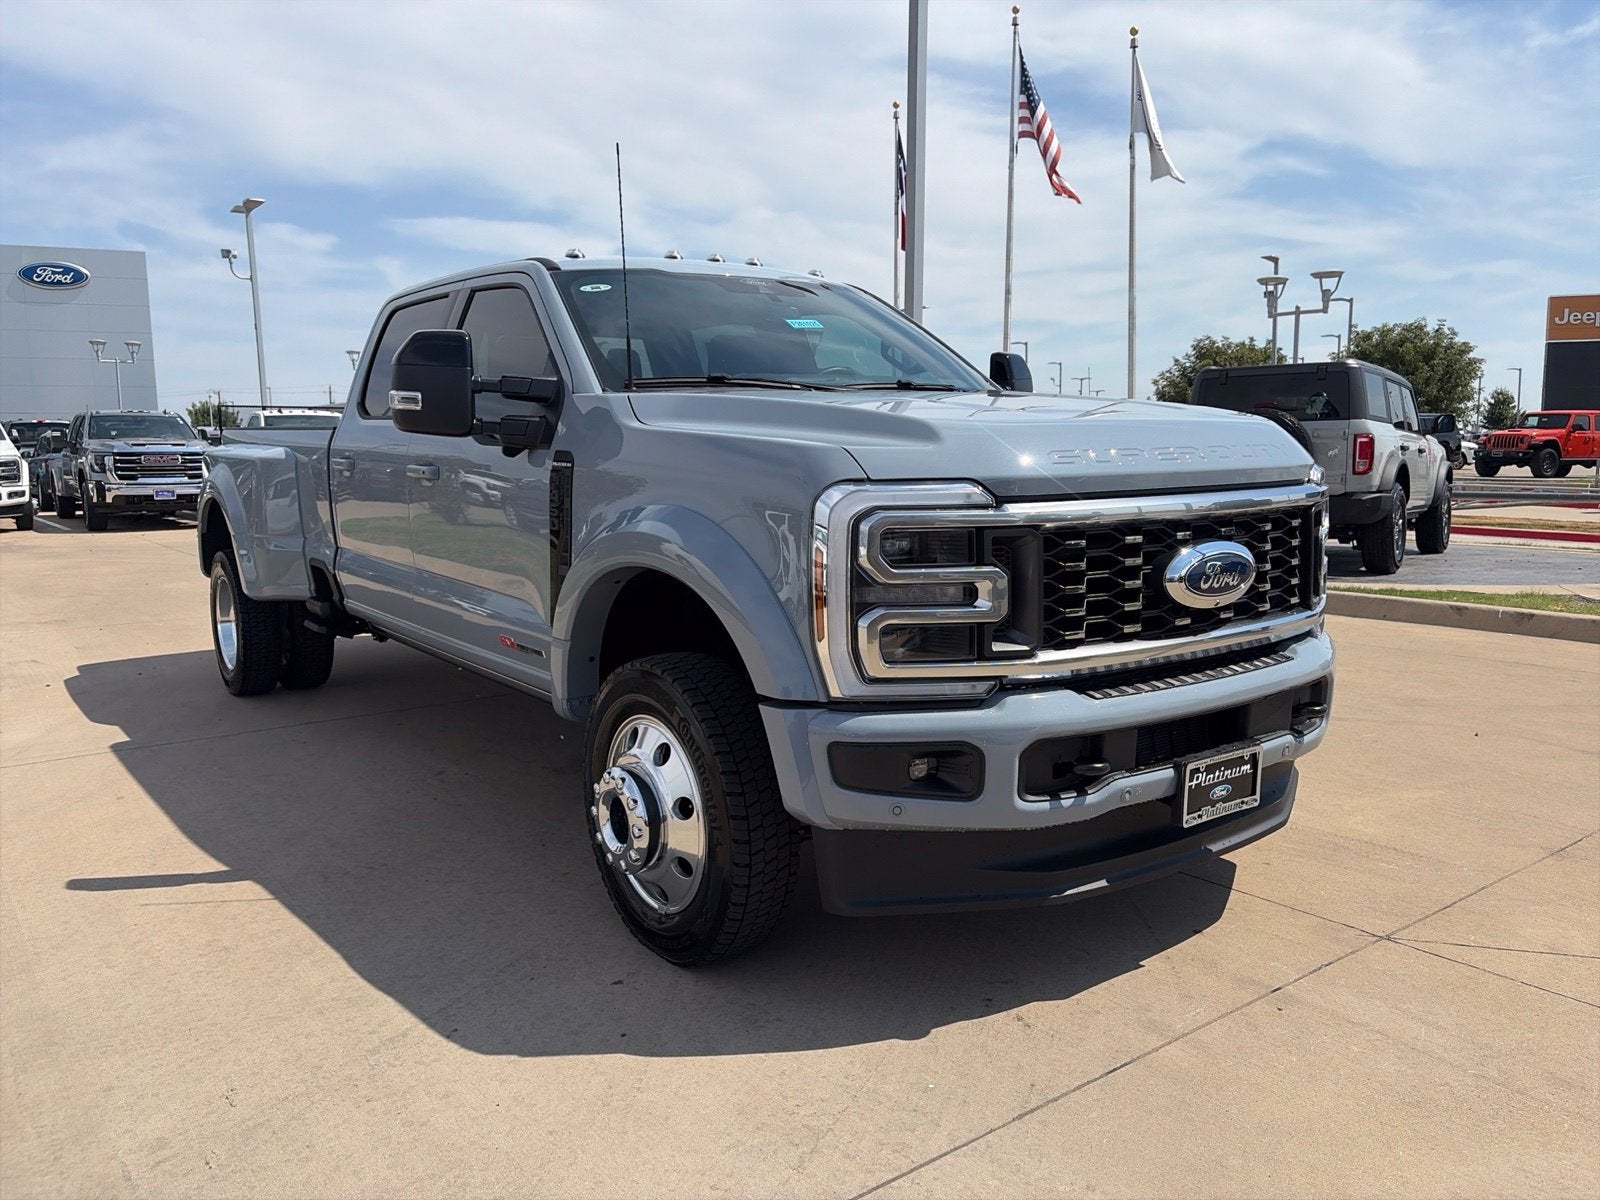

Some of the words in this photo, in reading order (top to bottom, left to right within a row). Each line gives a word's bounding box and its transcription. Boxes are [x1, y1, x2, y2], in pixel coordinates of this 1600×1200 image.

[33, 266, 74, 284] Ford
[1200, 561, 1241, 590] Ford
[1188, 763, 1254, 789] Platinum
[1200, 802, 1244, 820] Platinum
